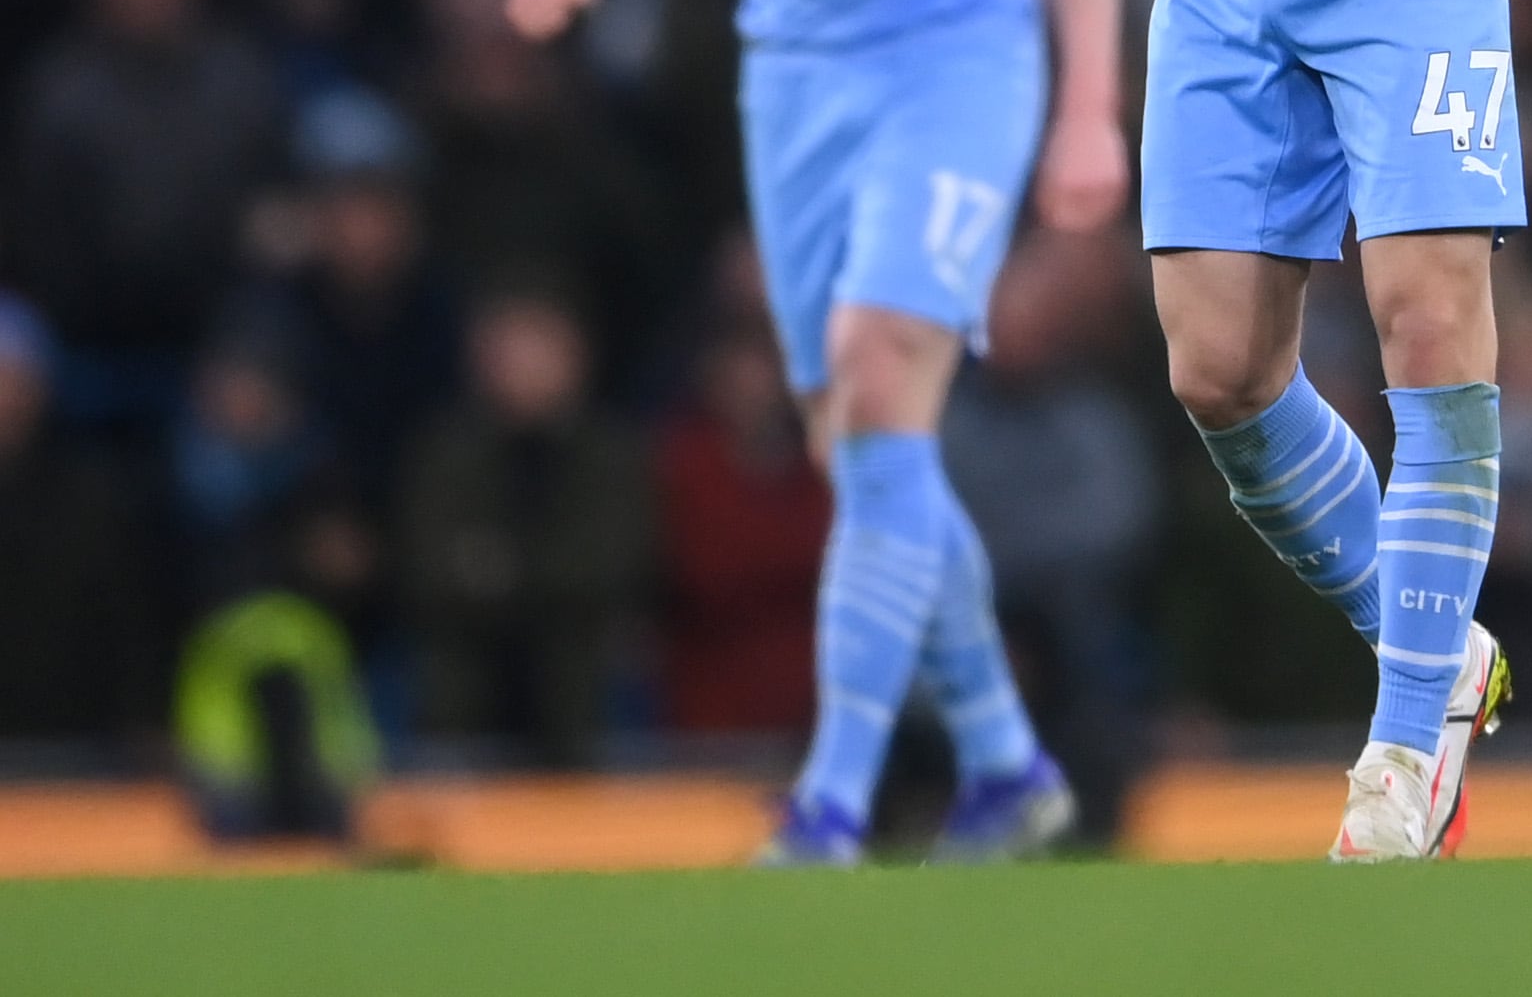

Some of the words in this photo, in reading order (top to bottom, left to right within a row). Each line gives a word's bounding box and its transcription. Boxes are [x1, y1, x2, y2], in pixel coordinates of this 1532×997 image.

[1411, 50, 1511, 152] 47
[927, 171, 1006, 261] 17
[1399, 587, 1469, 617] CITY
